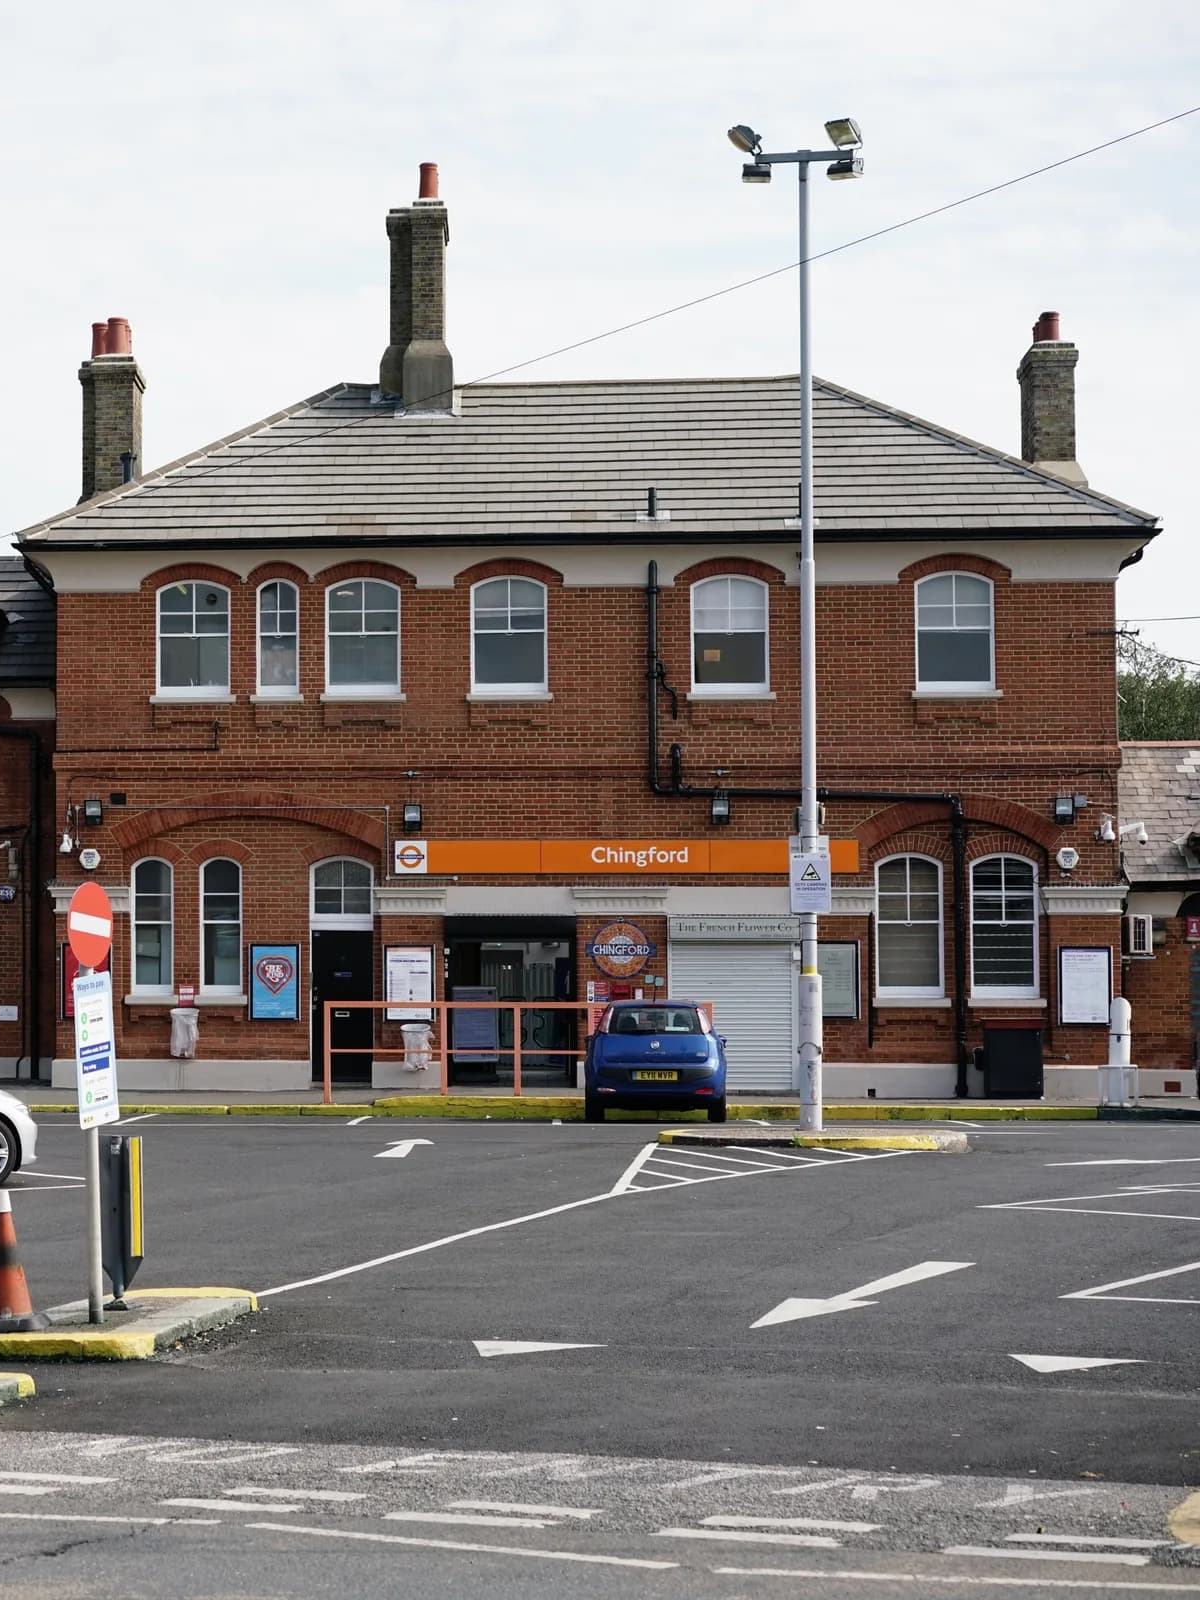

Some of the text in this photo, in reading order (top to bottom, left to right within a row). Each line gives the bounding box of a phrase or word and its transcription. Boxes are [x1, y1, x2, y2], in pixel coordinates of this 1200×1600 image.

[591, 846, 689, 867] Chingford
[675, 922, 696, 932] THE
[699, 922, 735, 932] FRENCH
[738, 922, 776, 932] FLOWER
[592, 945, 650, 955] CHINGFORD
[264, 964, 283, 974] BE
[266, 972, 284, 982] KIND
[76, 983, 90, 992] Ways
[95, 980, 104, 990] pay
